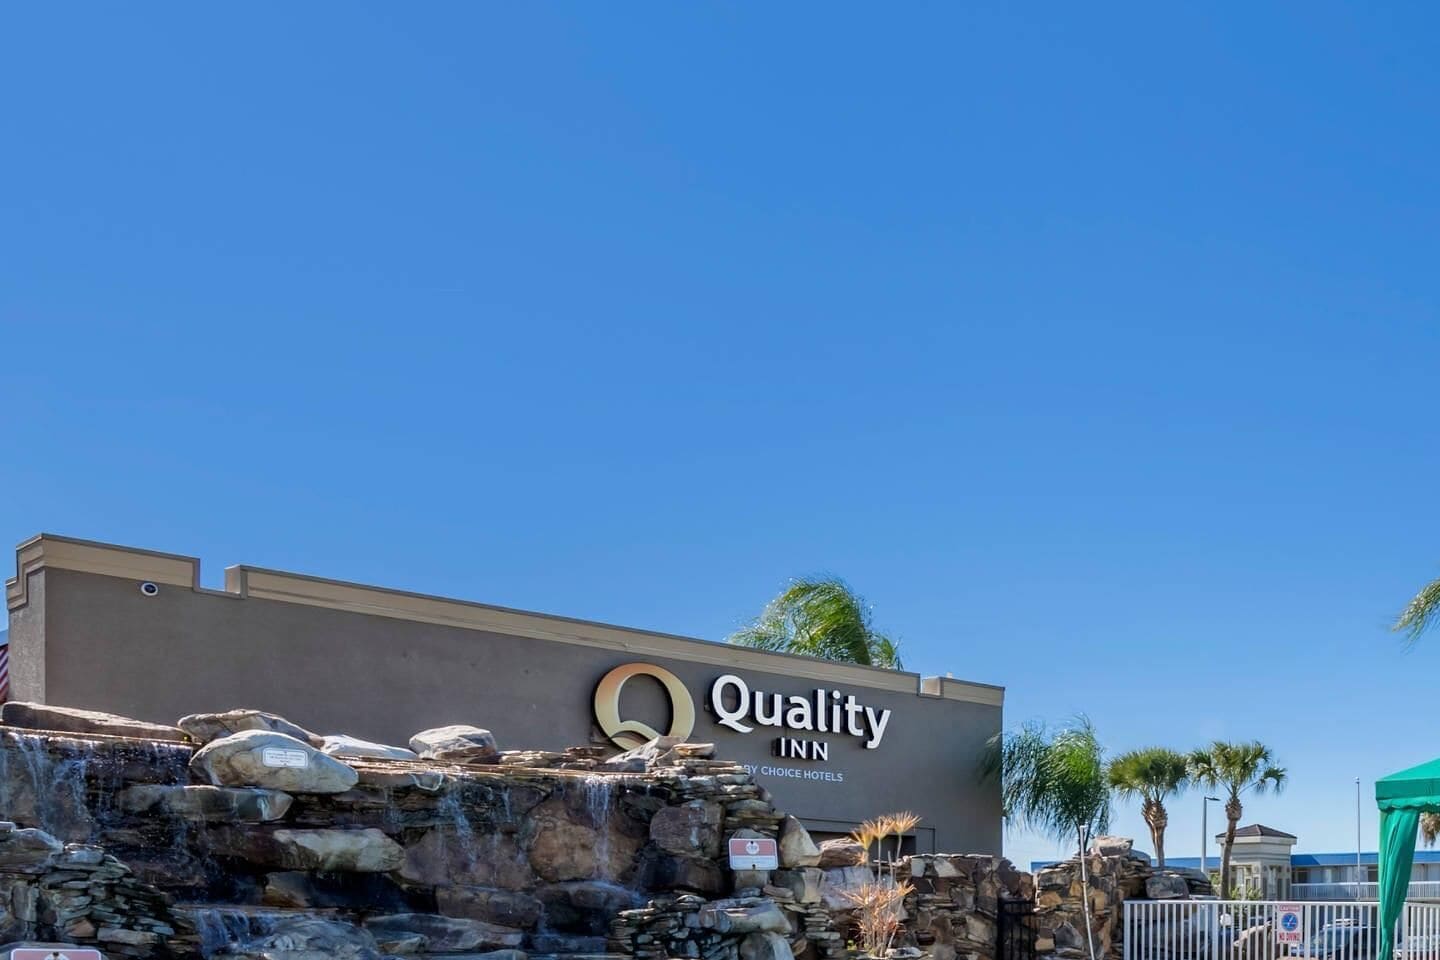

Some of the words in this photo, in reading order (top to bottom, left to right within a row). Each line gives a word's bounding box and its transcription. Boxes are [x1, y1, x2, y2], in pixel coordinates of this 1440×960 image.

[711, 674, 892, 750] Quality
[779, 737, 829, 762] INN
[743, 764, 758, 776] BY
[760, 766, 802, 778] CHOICE
[803, 770, 844, 783] HOTELS
